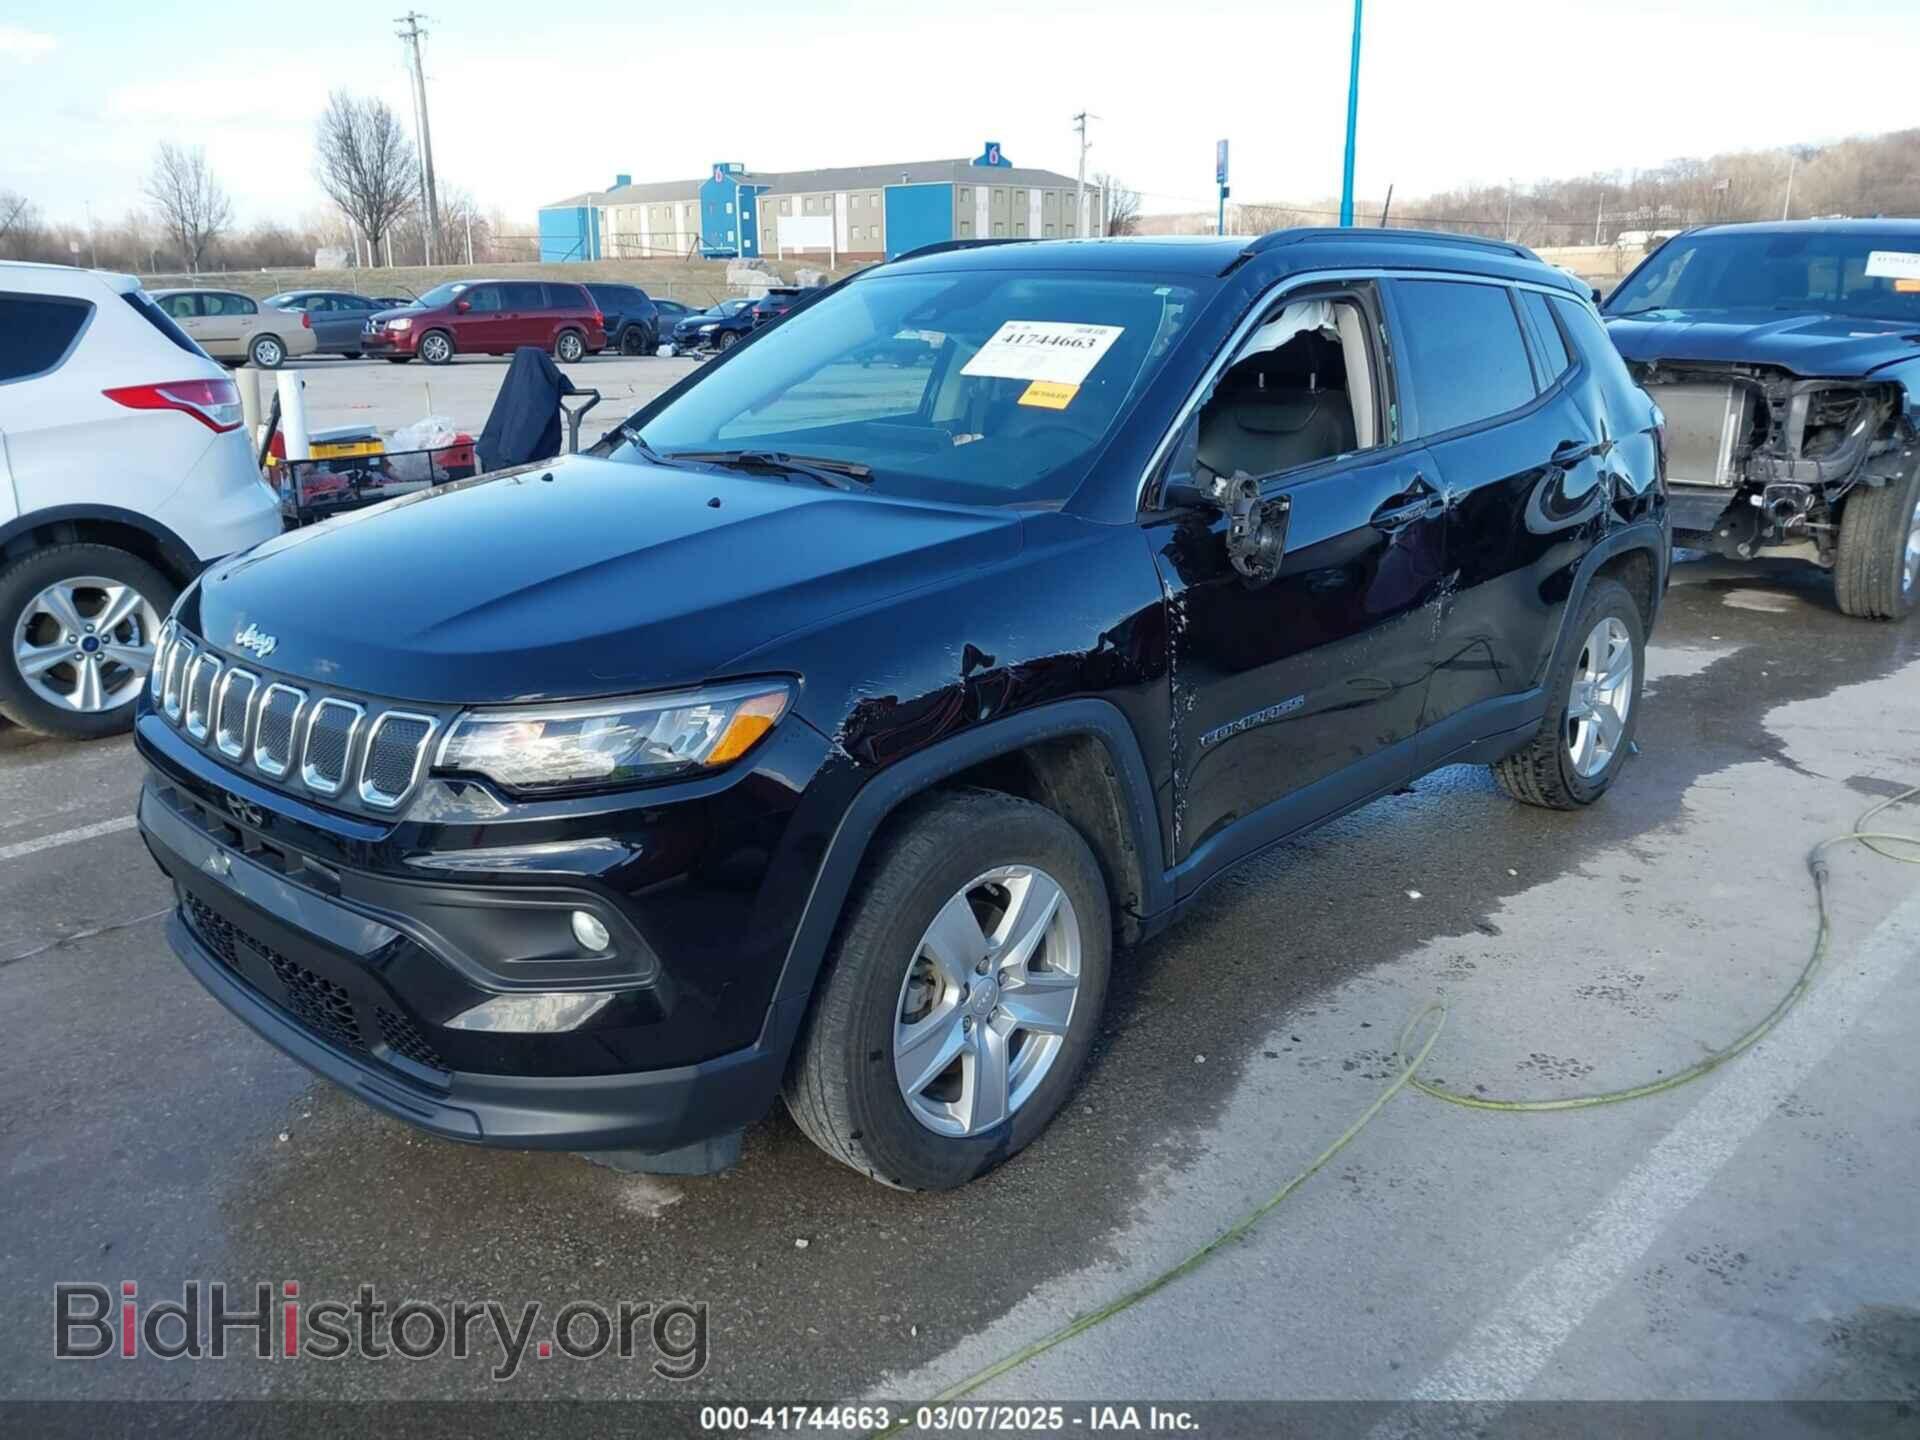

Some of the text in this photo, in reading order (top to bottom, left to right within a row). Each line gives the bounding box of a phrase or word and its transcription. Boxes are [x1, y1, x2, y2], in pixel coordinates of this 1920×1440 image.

[989, 145, 999, 165] 6
[1002, 333, 1097, 349] 41744663
[235, 623, 277, 658] Jeep
[1200, 695, 1304, 749] COMPASS
